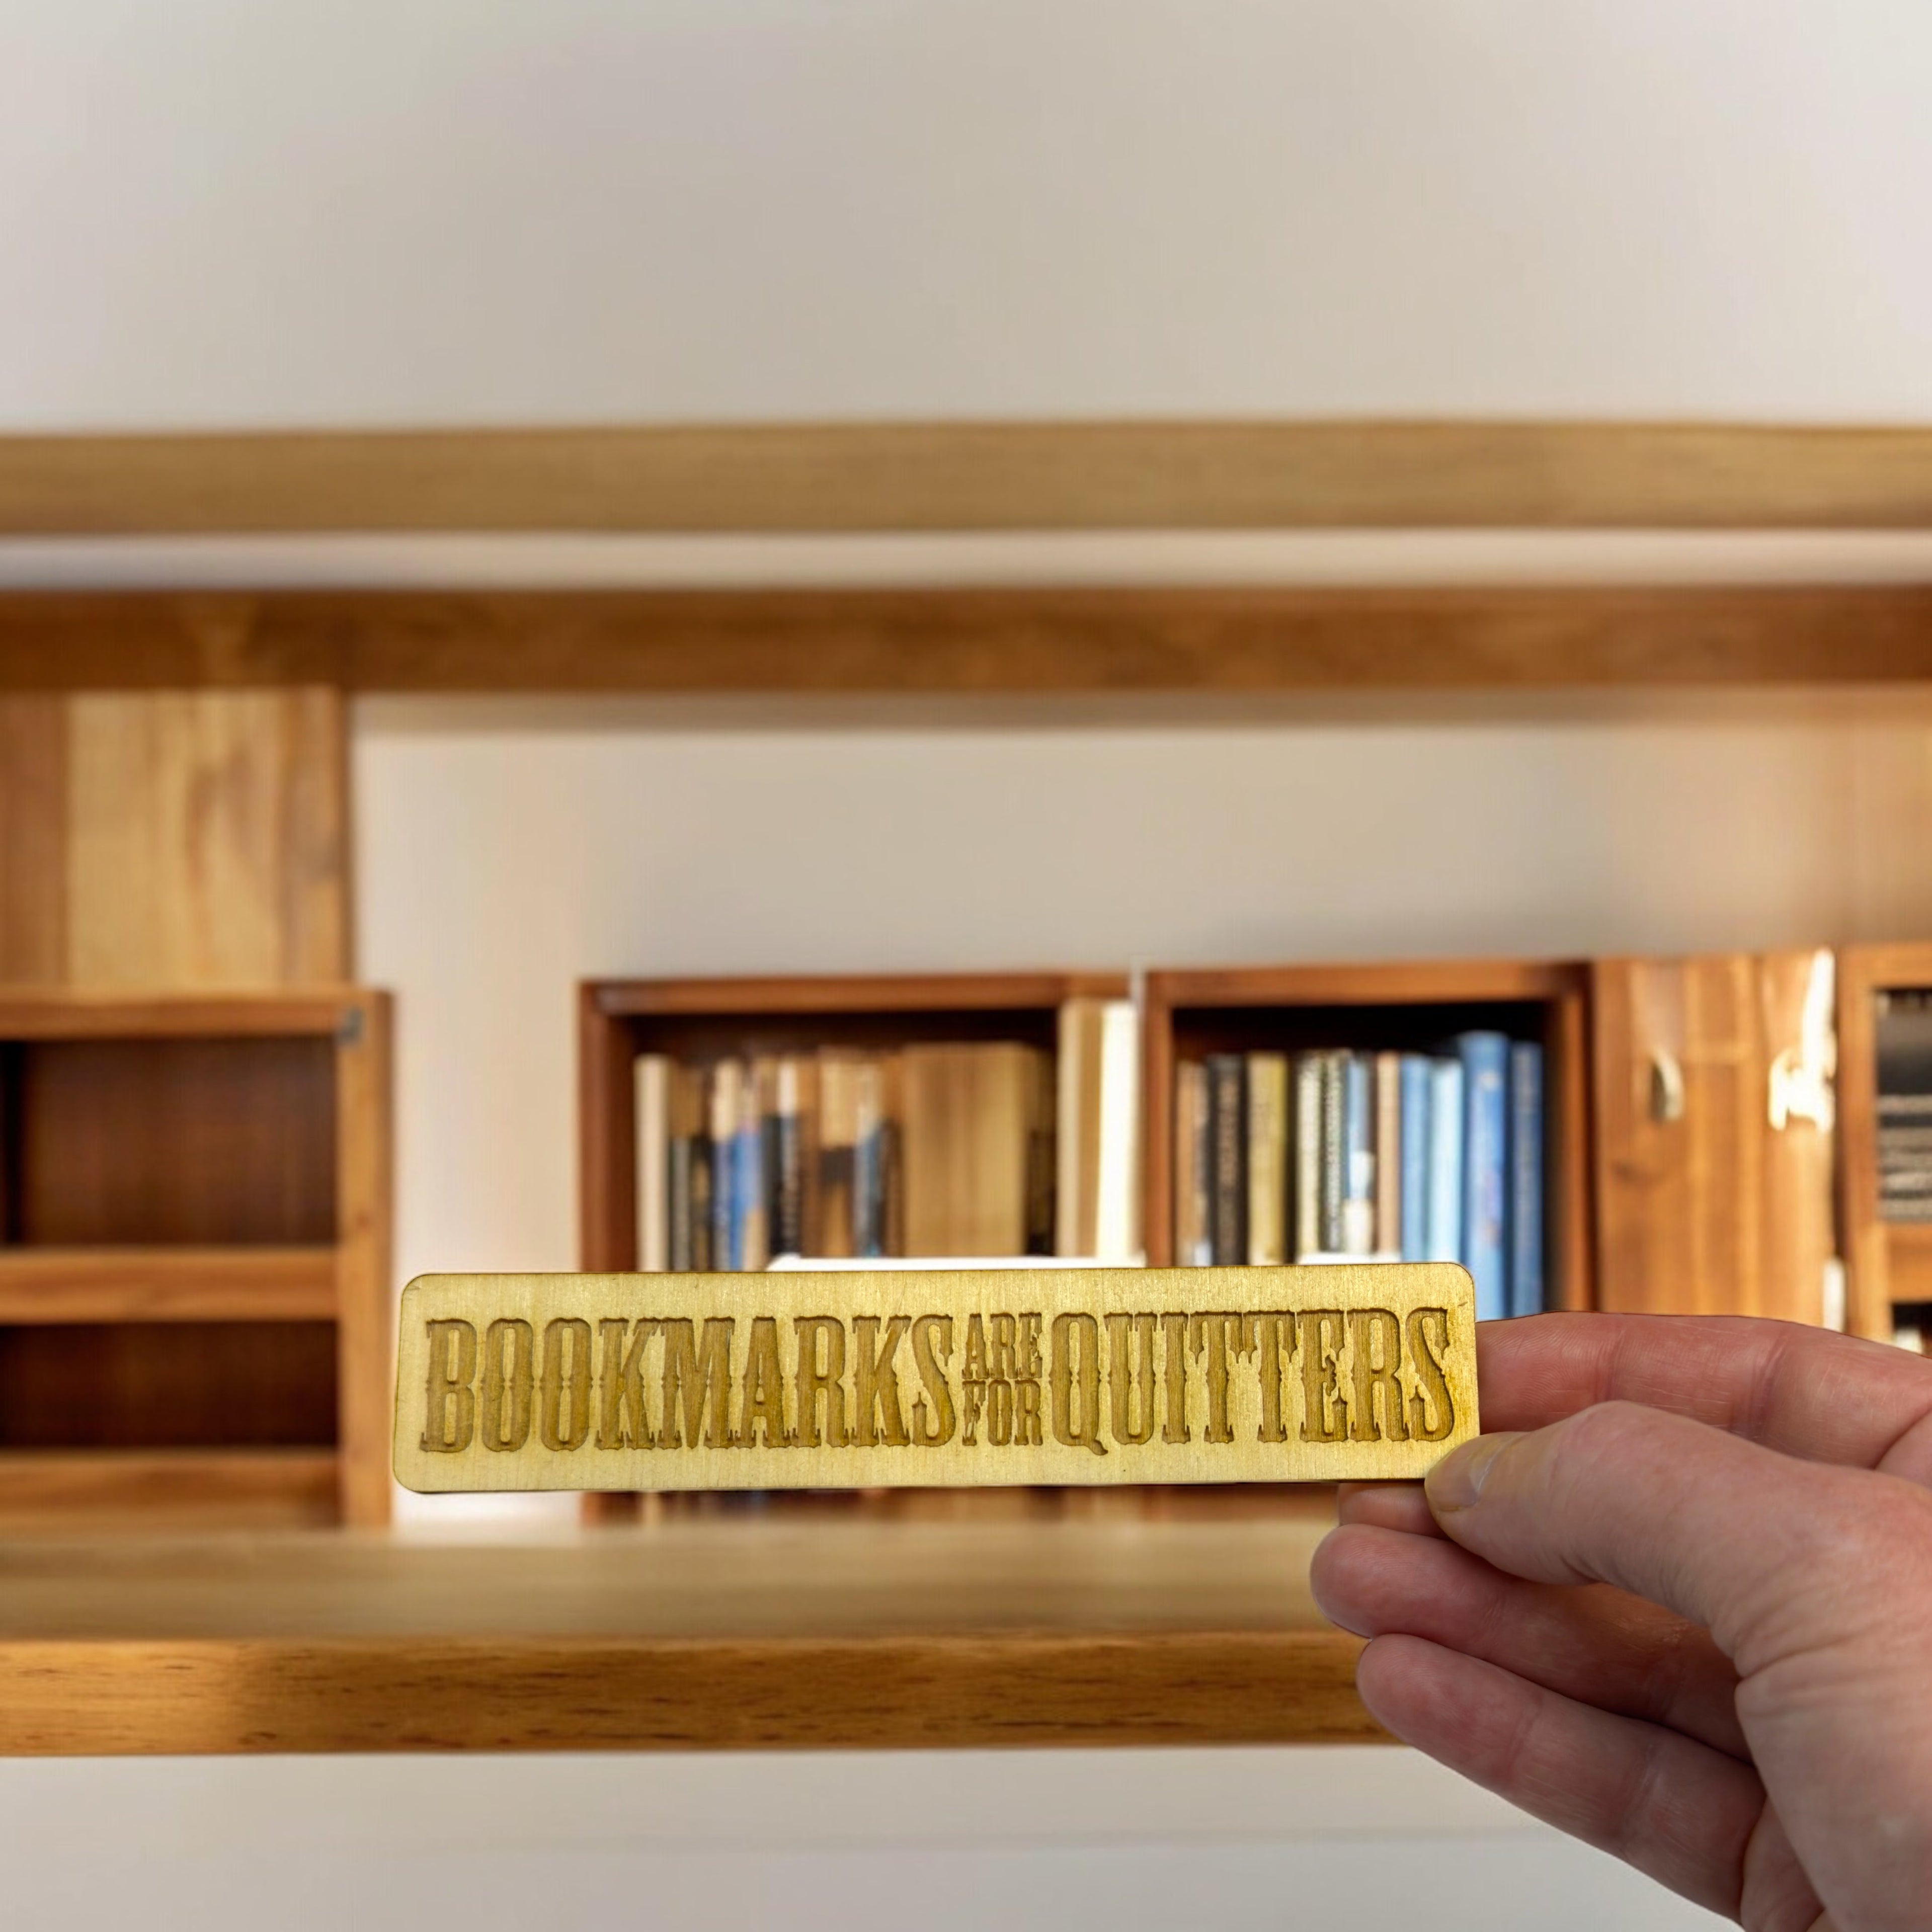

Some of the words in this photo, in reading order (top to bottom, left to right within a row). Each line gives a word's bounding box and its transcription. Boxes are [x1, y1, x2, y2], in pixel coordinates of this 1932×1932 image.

[419, 1313, 956, 1453] BOOKMARKS
[961, 1311, 1043, 1380] ARE
[1051, 1307, 1455, 1456] QUITTERS
[961, 1379, 1043, 1446] FOR
